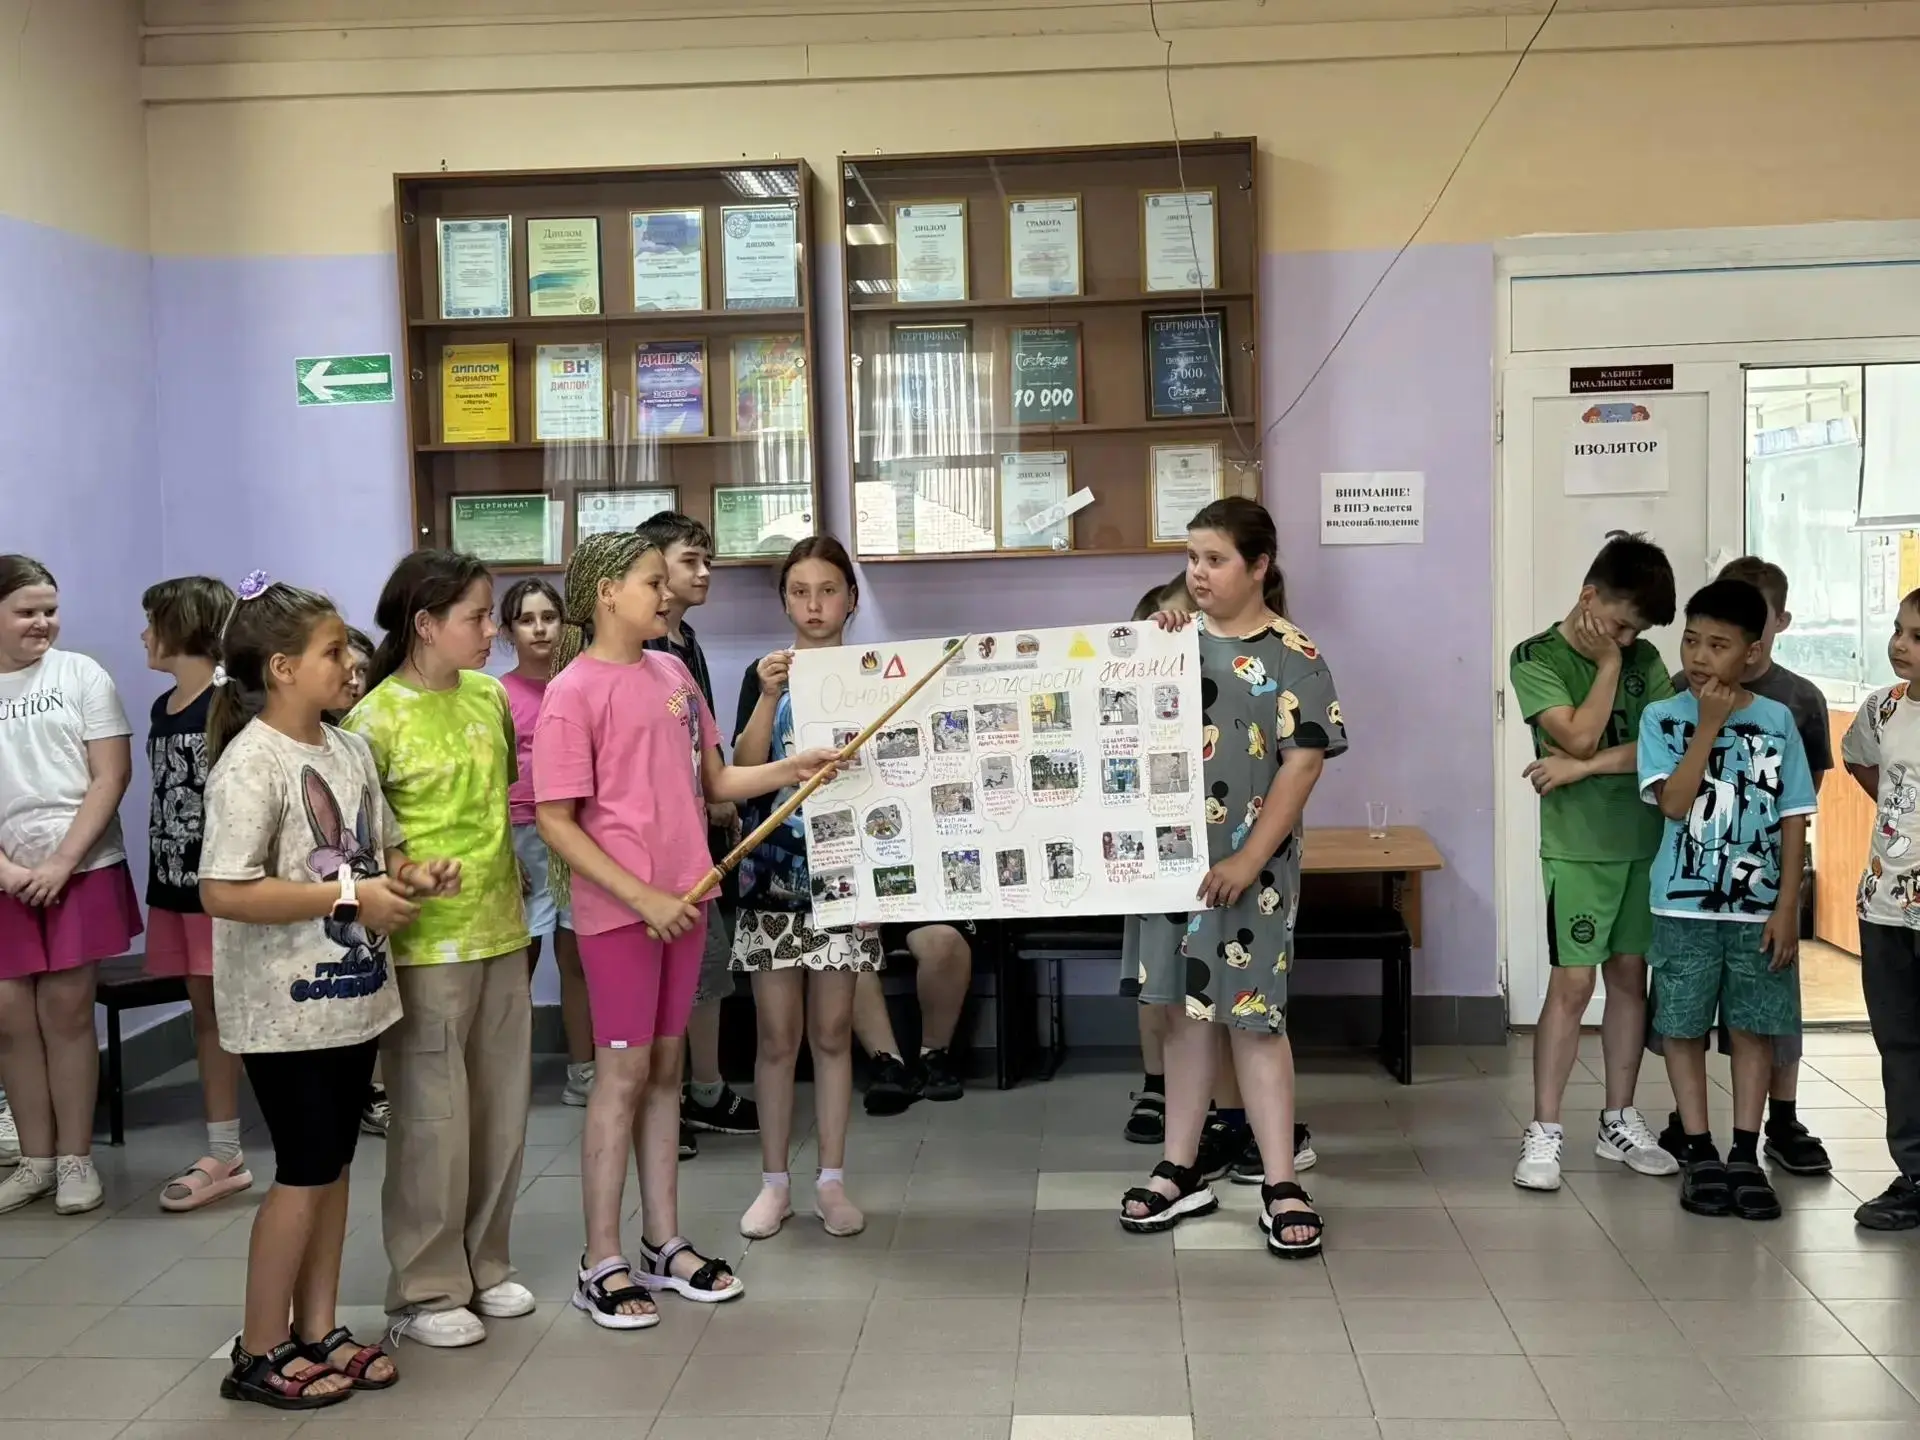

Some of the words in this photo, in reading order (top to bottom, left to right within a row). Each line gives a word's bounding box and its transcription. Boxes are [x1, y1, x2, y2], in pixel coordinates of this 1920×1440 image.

[912, 224, 947, 233] ДИПЛОМ
[1025, 219, 1061, 228] ГРАМОТА
[543, 228, 582, 239] Диплом
[1153, 319, 1217, 332] СЕРТИФИКАТ
[900, 330, 961, 342] СЕРТИФИКАТ
[639, 352, 700, 367] ДИПЛОМ
[451, 363, 500, 375] ДИПЛОМ
[551, 359, 590, 374] КВН
[1600, 369, 1643, 379] КАБИНЕТ
[550, 381, 591, 392] ДИПЛОМ
[1571, 378, 1628, 389] НАЧАЛЬНЫХ
[1629, 376, 1673, 388] КЛАССОВ
[1014, 389, 1035, 408] 10
[1039, 387, 1074, 407] 000
[1573, 440, 1658, 456] ИЗОЛЯТОР
[1334, 487, 1411, 498] ВНИМАНИЕ!
[474, 501, 529, 510] СЕРТИФИКАТ
[1333, 503, 1341, 513] В
[1344, 502, 1370, 513] ППЭ
[1372, 503, 1413, 513] ведется
[1326, 517, 1420, 528] видеонаблюдение
